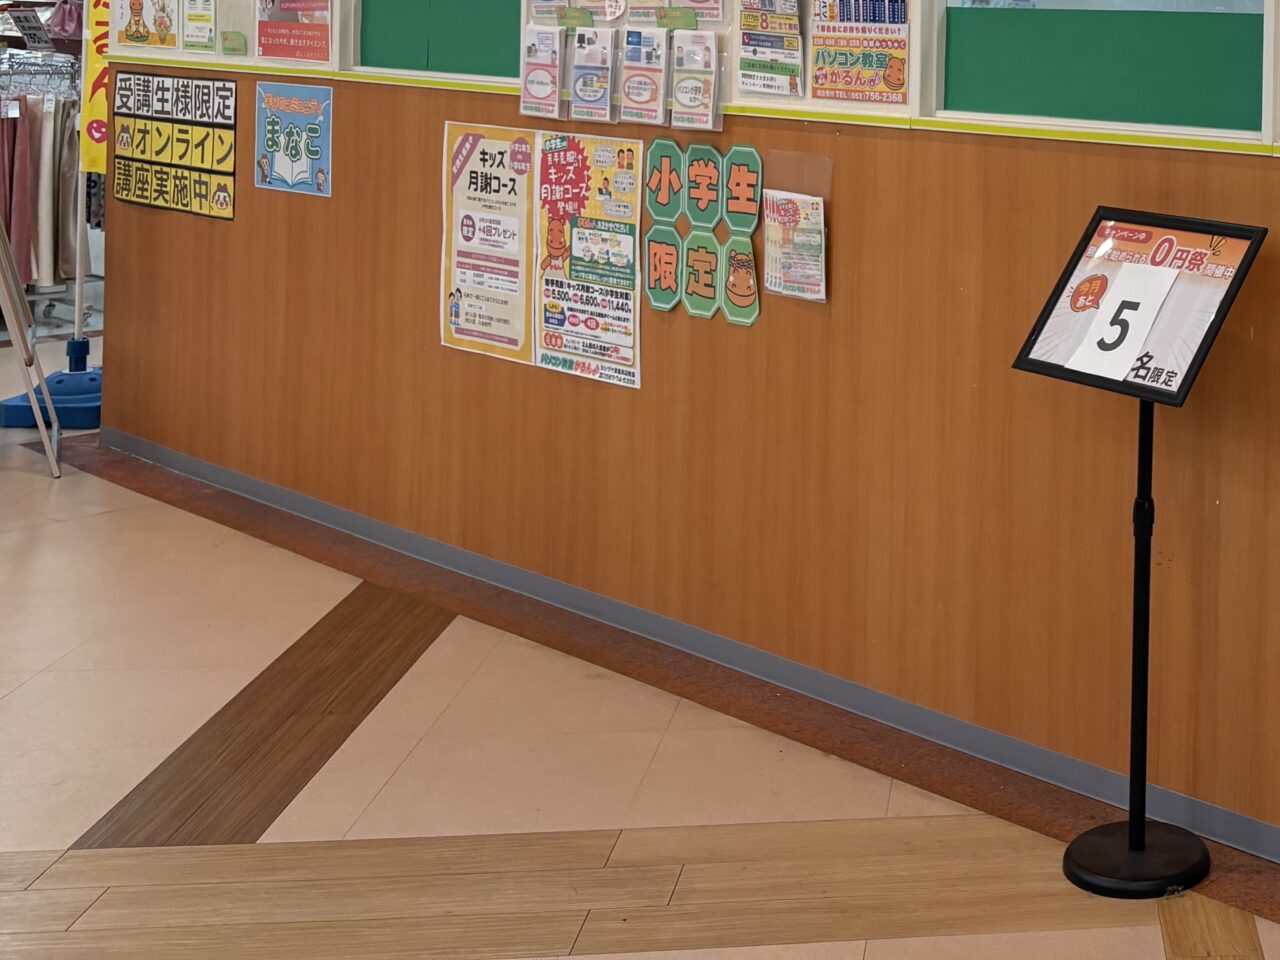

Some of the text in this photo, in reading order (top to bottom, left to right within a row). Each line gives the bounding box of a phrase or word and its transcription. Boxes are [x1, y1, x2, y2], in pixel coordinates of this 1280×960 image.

[814, 47, 889, 71] パソコン教室
[116, 76, 235, 122] 受講生様限定
[134, 122, 235, 167] オンライン
[264, 114, 322, 162] まなこ
[479, 147, 508, 170] キッズ
[467, 170, 518, 196] 月謝コース
[548, 163, 577, 183] キッズ
[647, 154, 760, 216] 小学生
[115, 161, 210, 212] 講座実施中
[541, 182, 589, 201] 月謝コース
[1103, 228, 1148, 241] キャンペーン中
[648, 241, 718, 300] 限定
[1202, 263, 1237, 281] 開催中
[1079, 279, 1102, 295] 今月
[1075, 294, 1094, 307] あと
[1096, 299, 1141, 352] 5
[1131, 351, 1179, 389] 名限定
